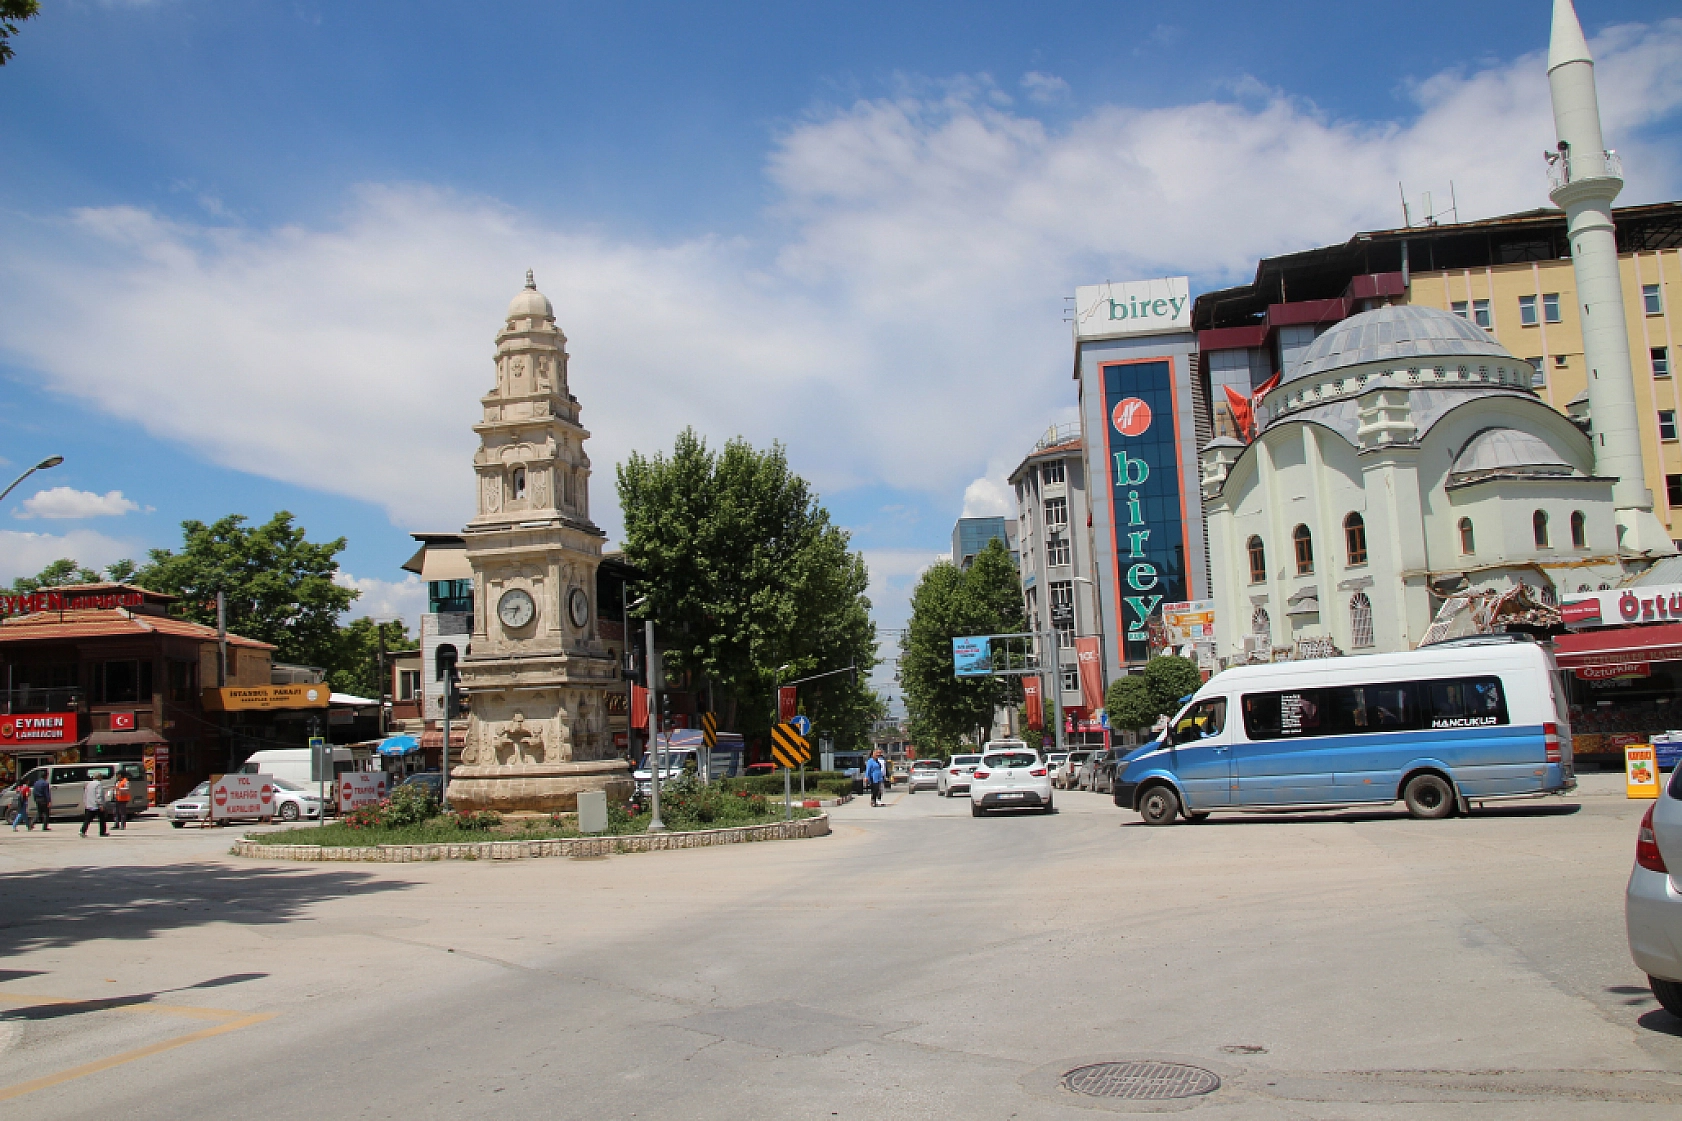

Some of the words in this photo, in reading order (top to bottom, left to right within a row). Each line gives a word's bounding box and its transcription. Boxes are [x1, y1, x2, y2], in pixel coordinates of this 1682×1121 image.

[1108, 294, 1187, 320] birey
[1113, 450, 1163, 631] birey
[16, 717, 63, 728] EYMEN
[237, 777, 251, 785] YOL
